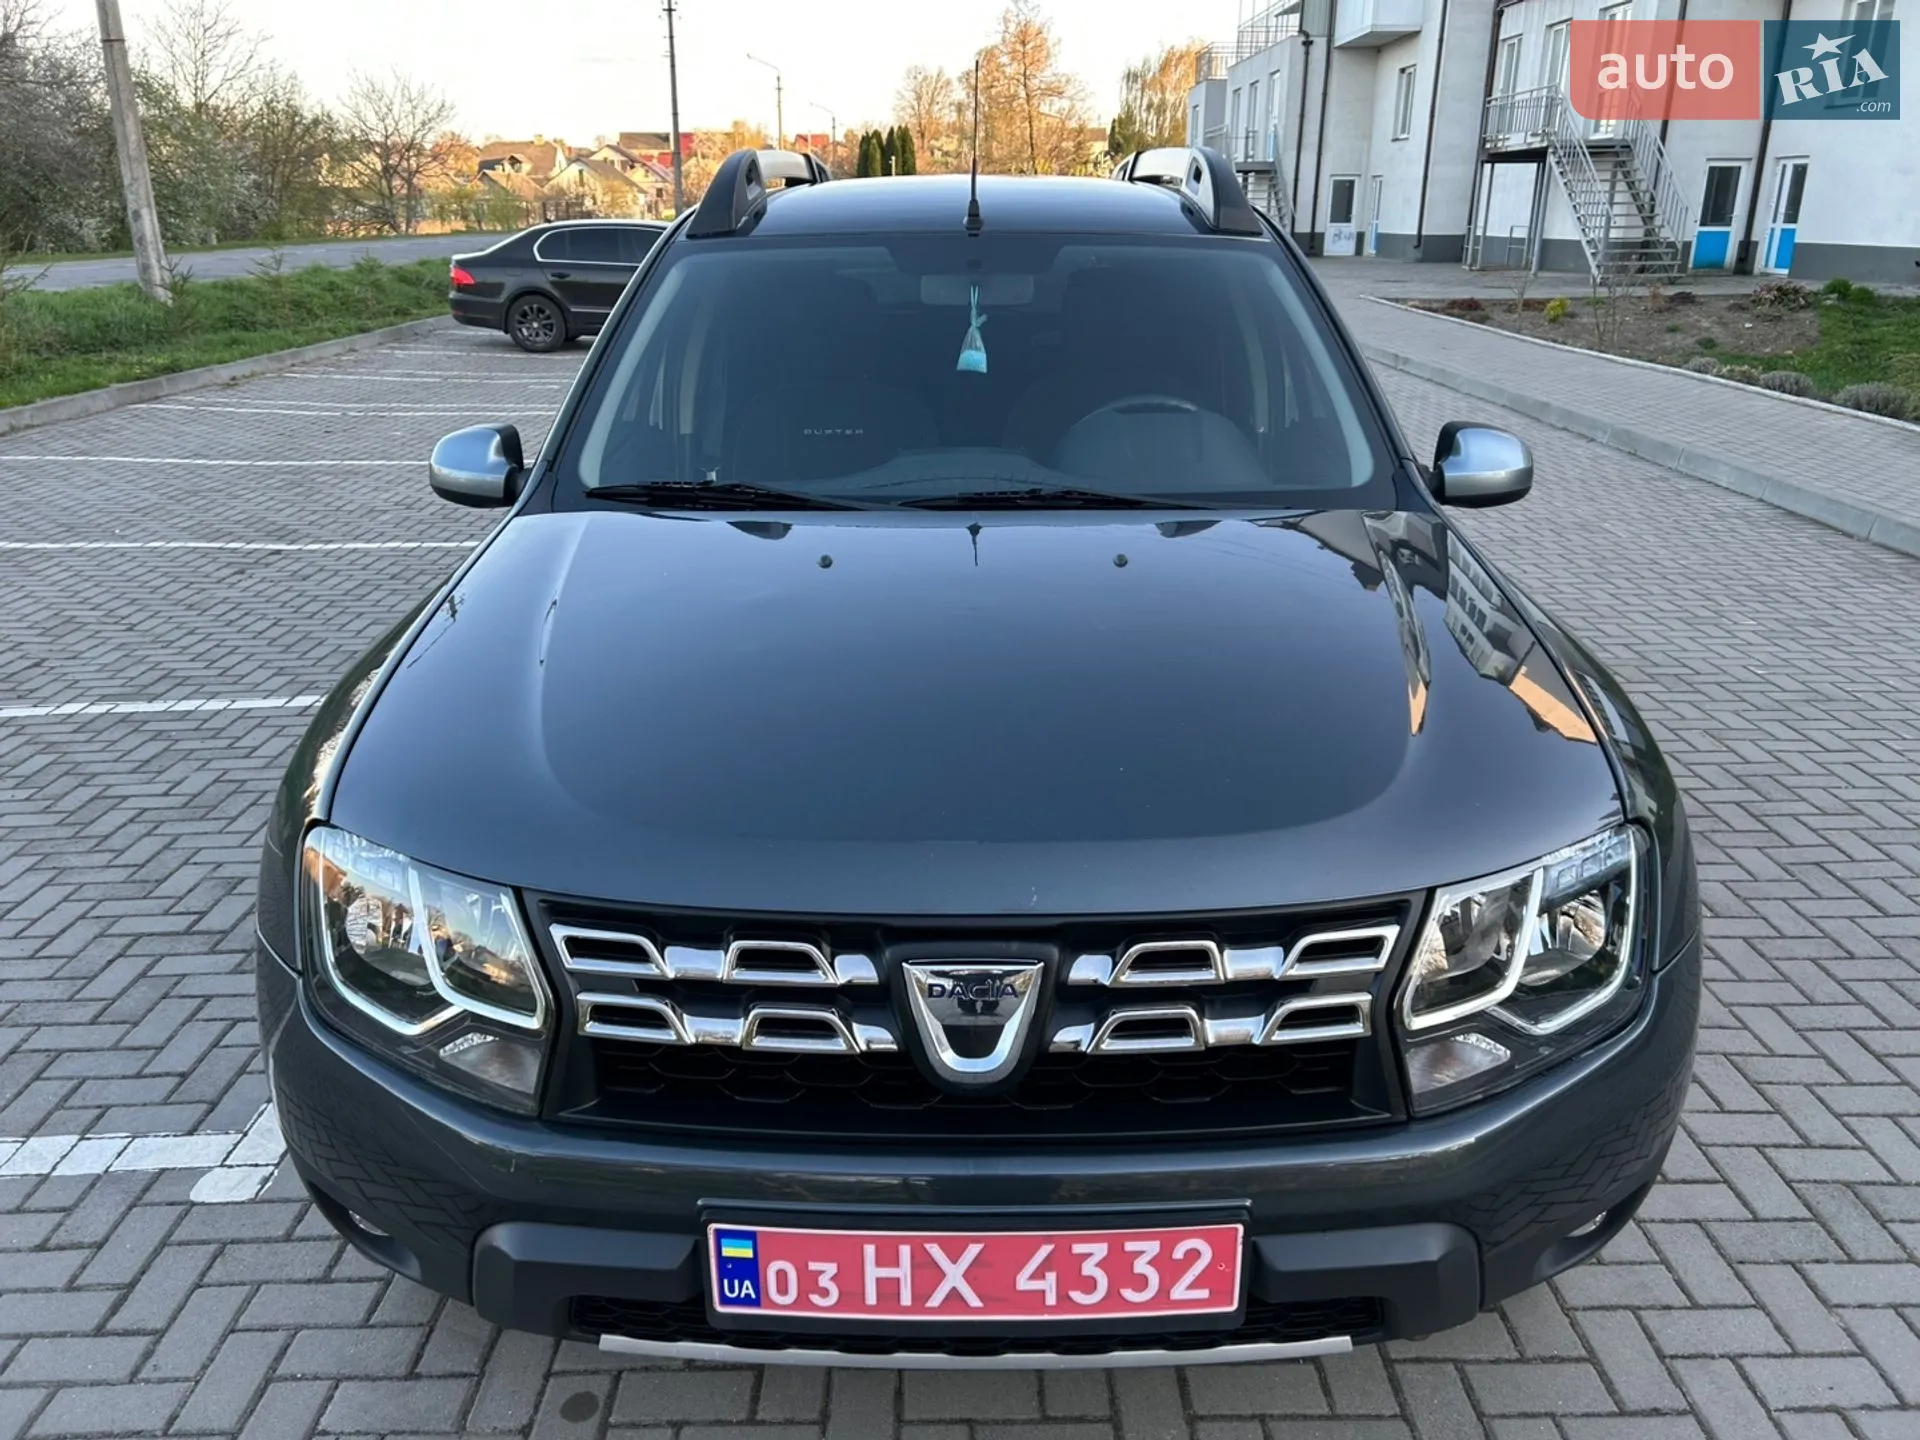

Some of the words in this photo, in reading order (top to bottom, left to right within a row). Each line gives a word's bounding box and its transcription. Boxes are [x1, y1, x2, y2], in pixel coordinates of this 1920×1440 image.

[927, 980, 1019, 1000] DACIA
[766, 1260, 839, 1307] 03
[863, 1243, 985, 1308] HX
[1015, 1238, 1213, 1307] 4332
[723, 1278, 756, 1299] UA
